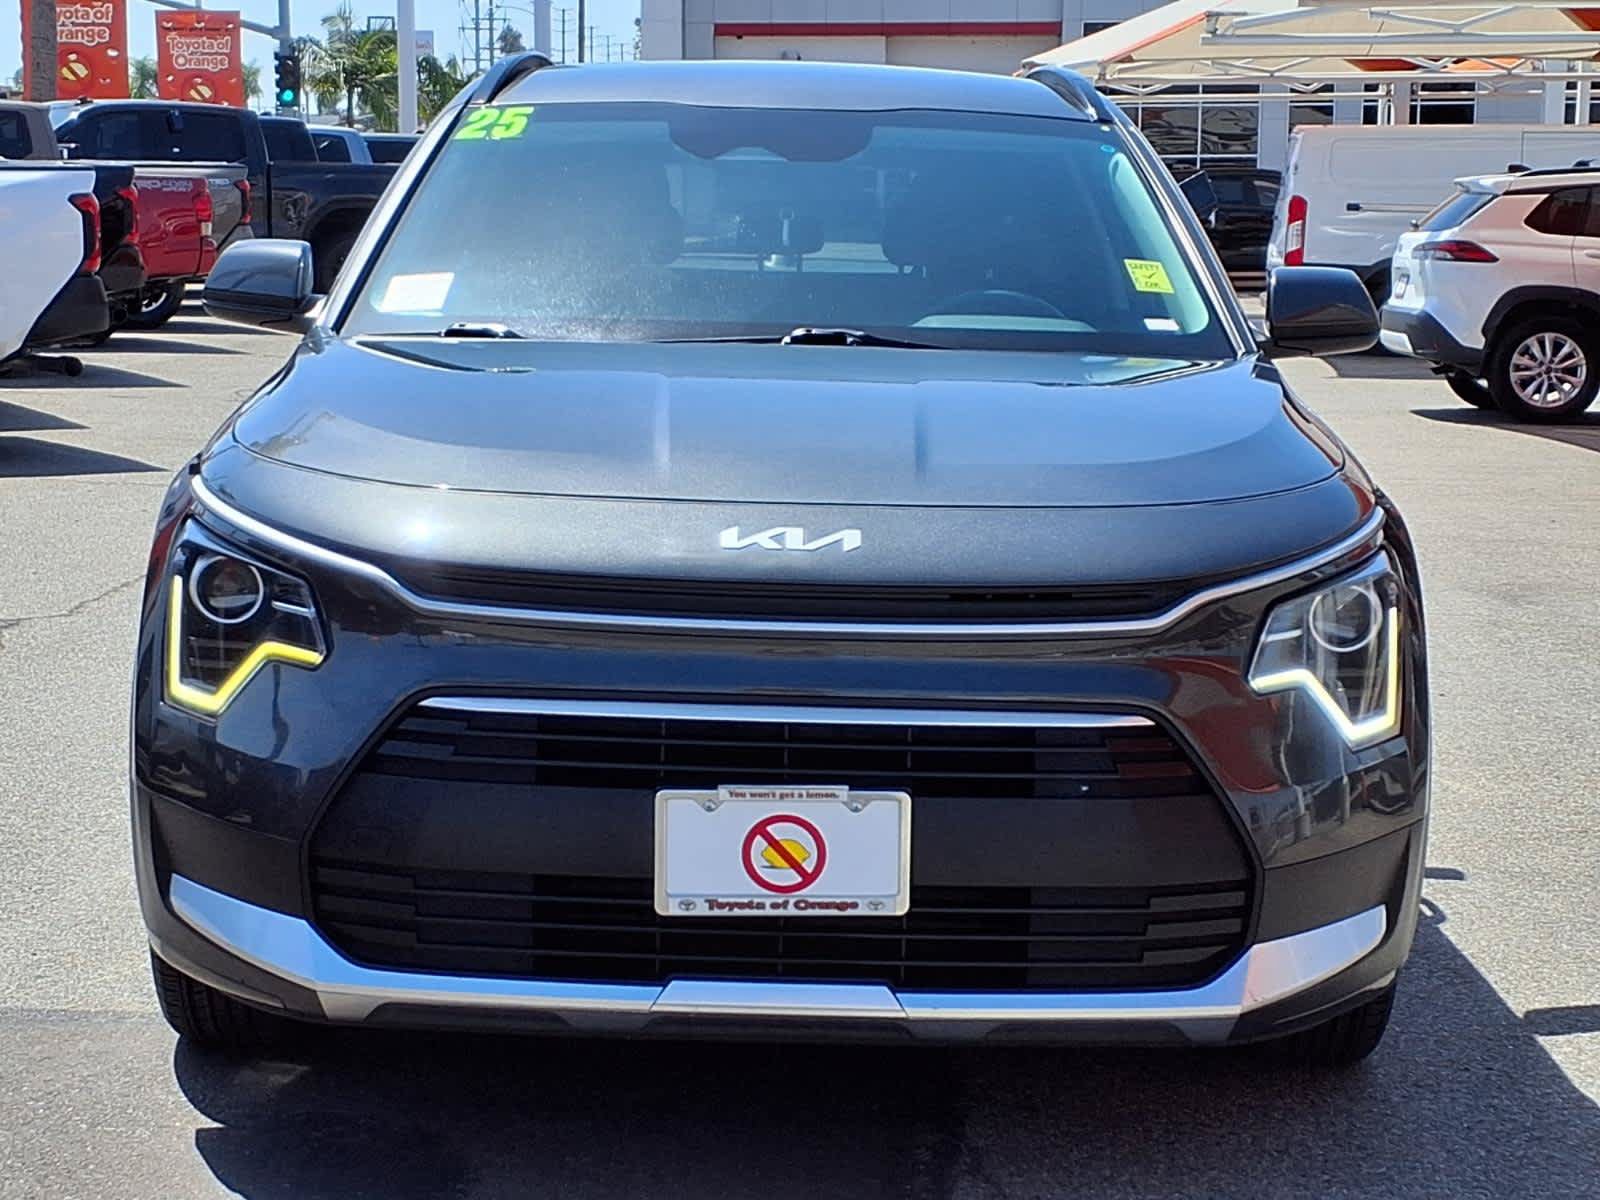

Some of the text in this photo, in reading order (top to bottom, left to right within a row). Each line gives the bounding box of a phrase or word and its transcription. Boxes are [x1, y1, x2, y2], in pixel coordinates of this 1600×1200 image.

[56, 4, 113, 24] yota of
[57, 26, 109, 45] range
[166, 35, 231, 54] Toyota of
[173, 54, 228, 71] Orange
[453, 106, 535, 140] 25
[720, 526, 861, 552] KIA
[728, 789, 746, 799] You
[749, 790, 777, 799] won't
[779, 791, 795, 800] get
[704, 899, 859, 913] Toyota of Orange
